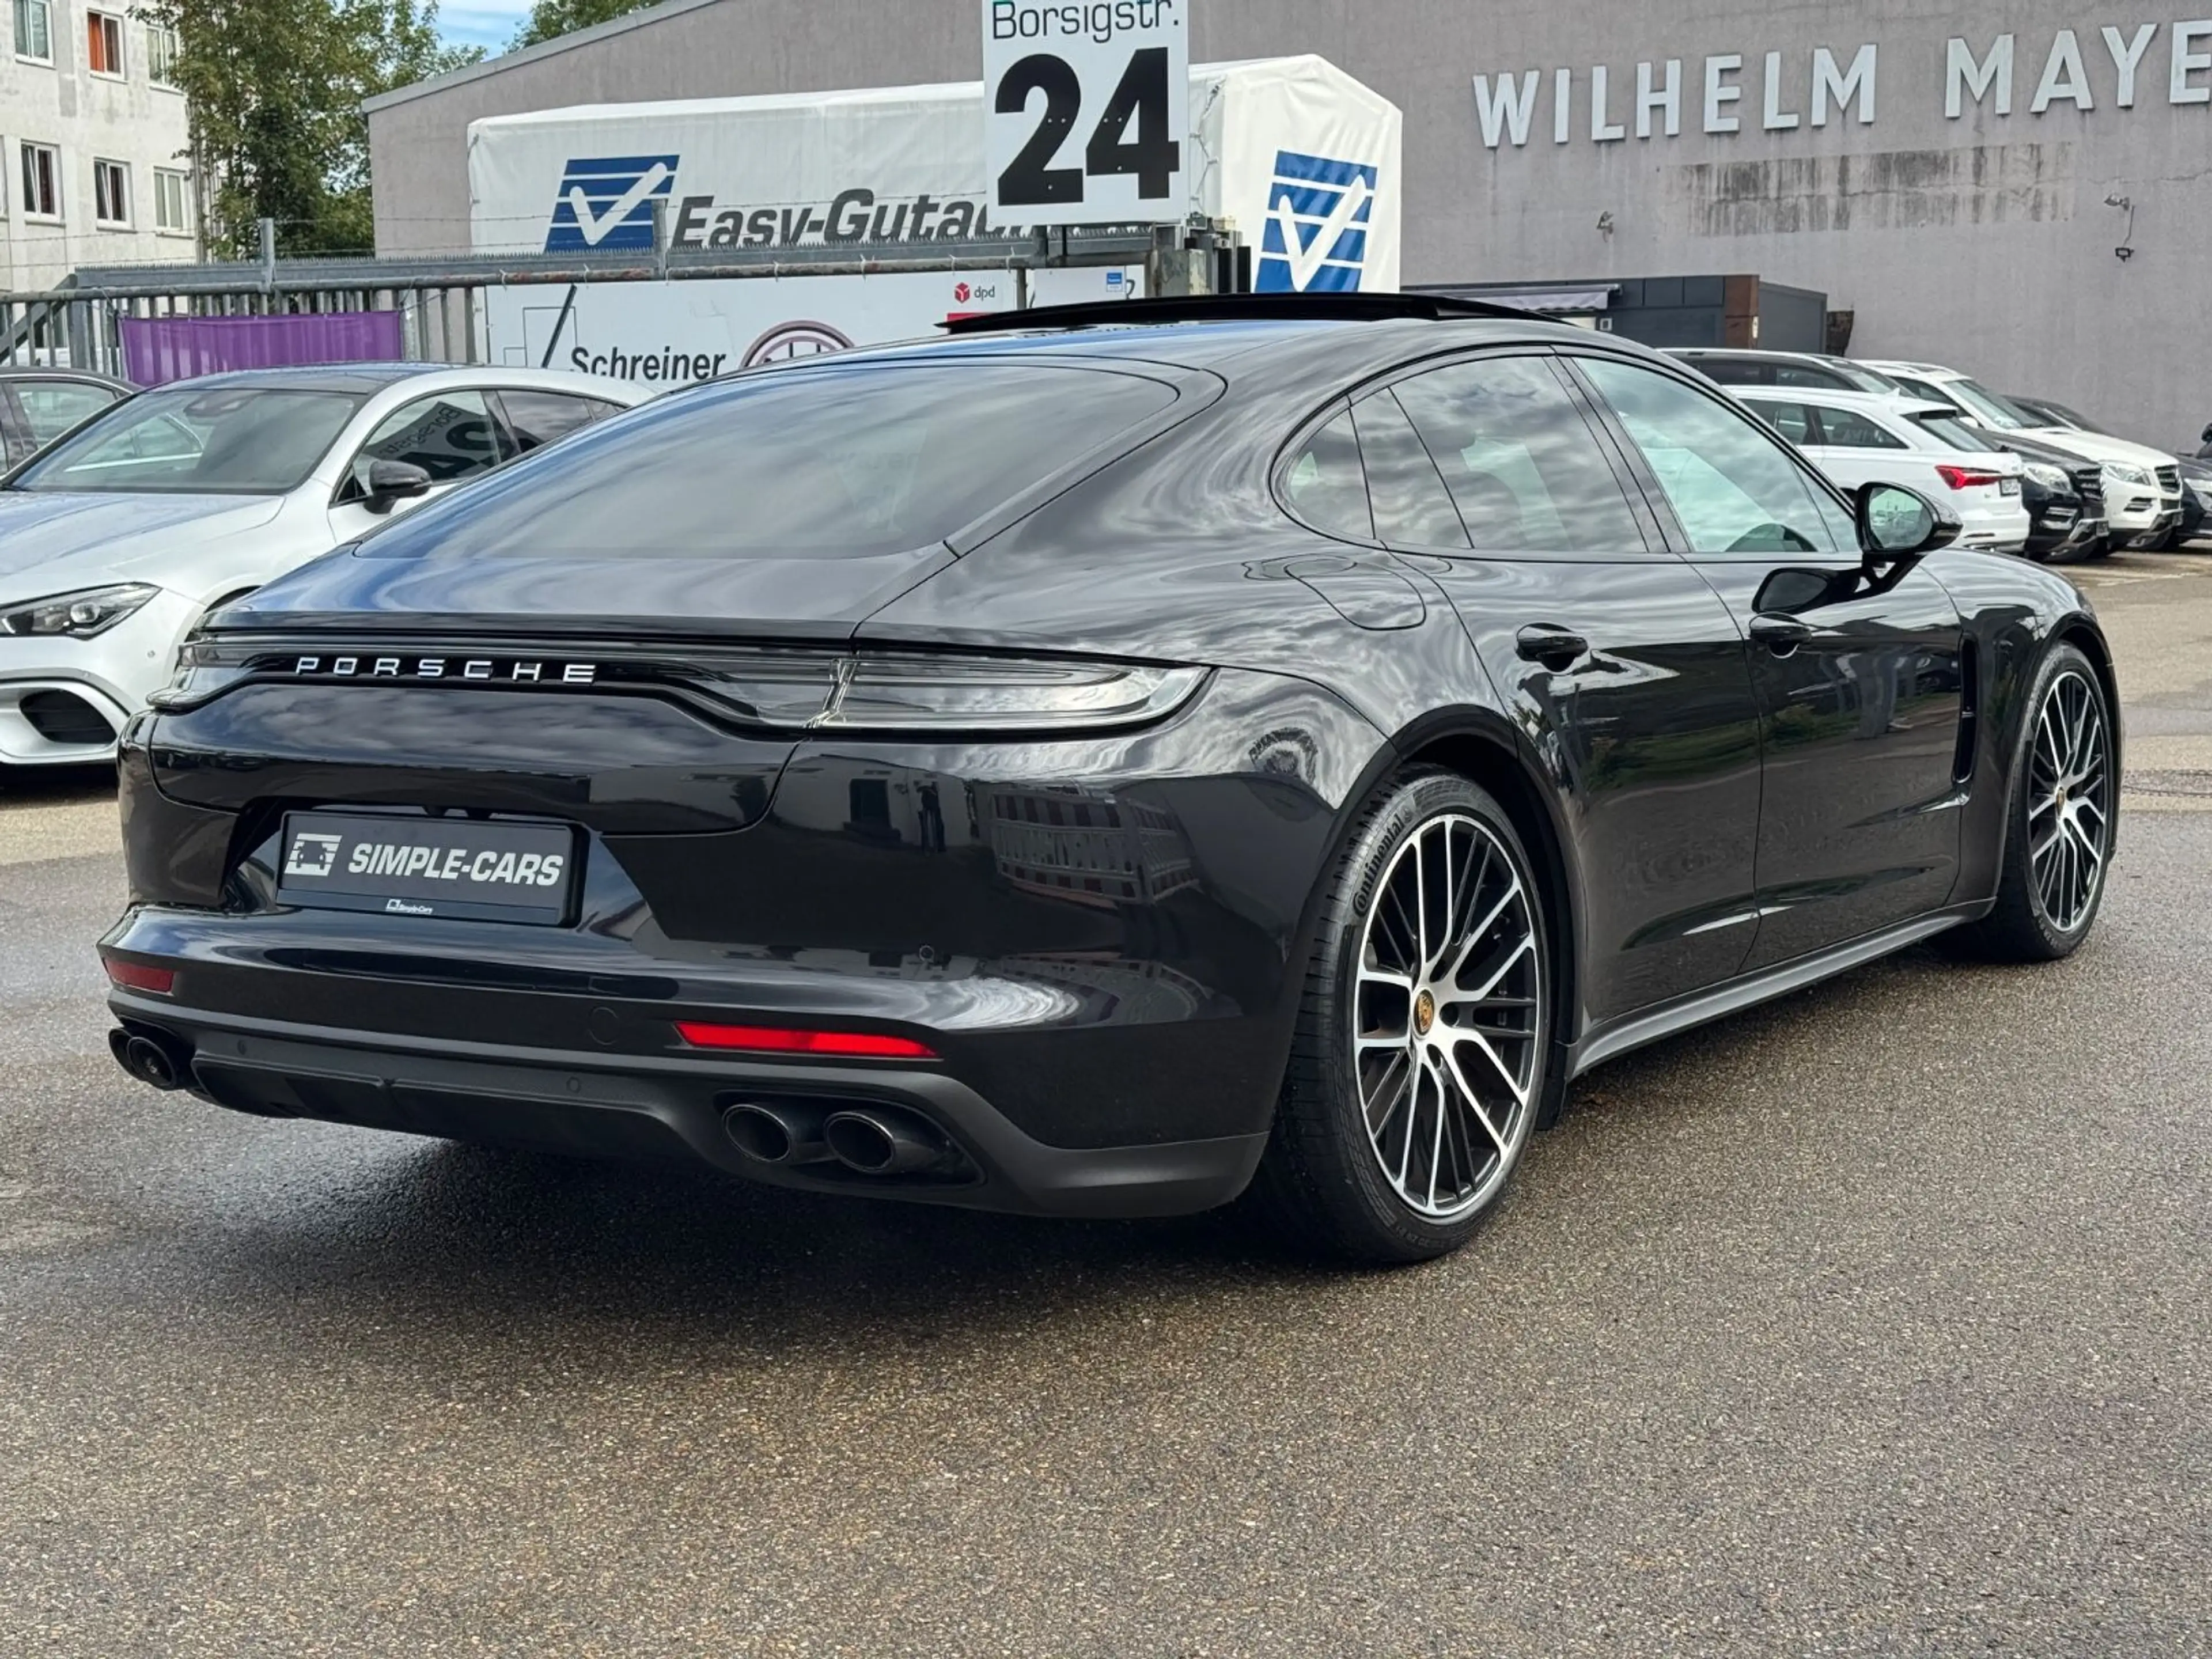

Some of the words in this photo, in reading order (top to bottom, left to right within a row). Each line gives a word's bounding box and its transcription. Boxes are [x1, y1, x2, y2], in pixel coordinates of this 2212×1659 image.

[993, 0, 1179, 43] Borsigstr.
[1472, 44, 1877, 147] WILHELM
[1945, 20, 2212, 118] MAYE
[995, 47, 1180, 206] 24
[974, 286, 995, 301] dpd
[570, 346, 726, 380] Schreiner
[296, 657, 596, 683] PORSCHE
[348, 843, 563, 886] SIMPLE-CARS
[1354, 813, 1406, 916] Continental
